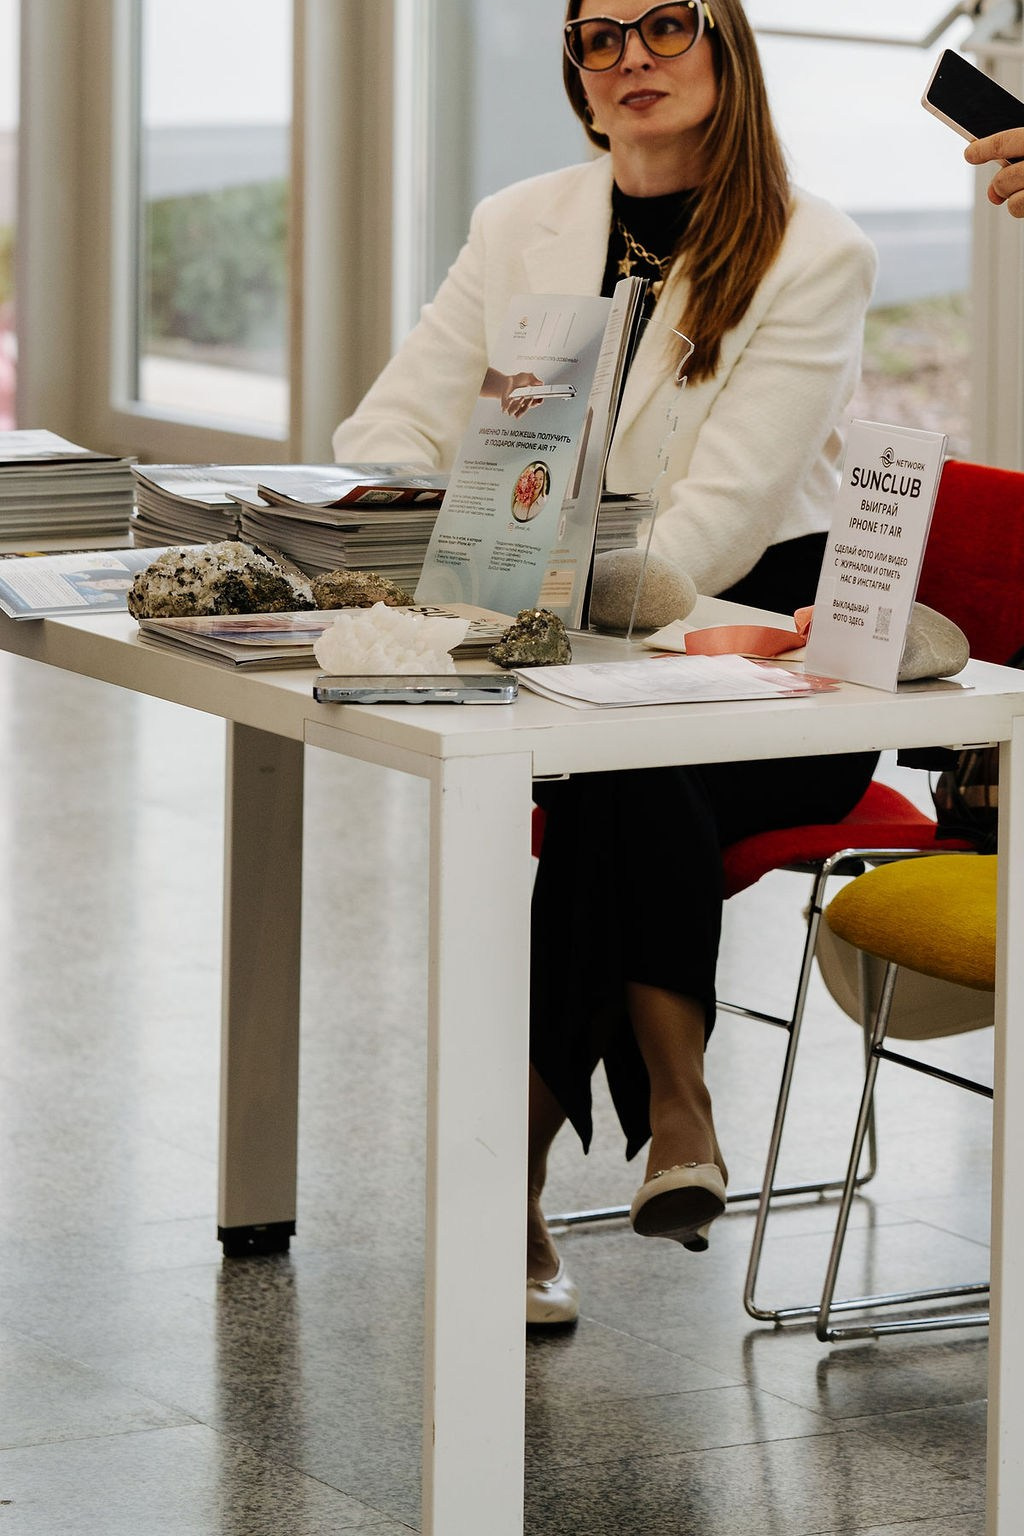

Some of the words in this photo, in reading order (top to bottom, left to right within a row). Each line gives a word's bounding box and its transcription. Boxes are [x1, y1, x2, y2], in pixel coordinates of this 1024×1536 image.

[488, 439, 515, 448] ПОДАРОК
[515, 443, 537, 451] IPHONE
[509, 430, 536, 439] МОЖЕШЬ
[536, 433, 571, 444] ПОЛУЧИТЬ
[896, 459, 926, 471] NETWORK
[850, 467, 922, 498] SUNCLUB
[860, 499, 899, 517] ВЫИГРАЙ
[849, 517, 878, 533] IPHONE
[880, 523, 887, 535] 17
[889, 525, 903, 538] AIR
[834, 543, 857, 555] СДЕЛАЙ
[857, 548, 874, 559] ФОТО
[874, 551, 887, 561] ИЛИ
[888, 554, 908, 567] ВИДЕО
[834, 558, 839, 566] С
[840, 559, 873, 573] ЖУРНАЛОМ
[873, 566, 879, 574] И
[879, 567, 901, 580] ОТМЕТЬ
[840, 574, 851, 584] НАС
[852, 576, 857, 585] В
[857, 577, 891, 592] ИНСТАГРАМ
[832, 599, 870, 614] ВЫКЛАДЫВАЙ
[832, 613, 848, 623] ФОТО
[848, 616, 865, 627] ЗДЕСЬ
